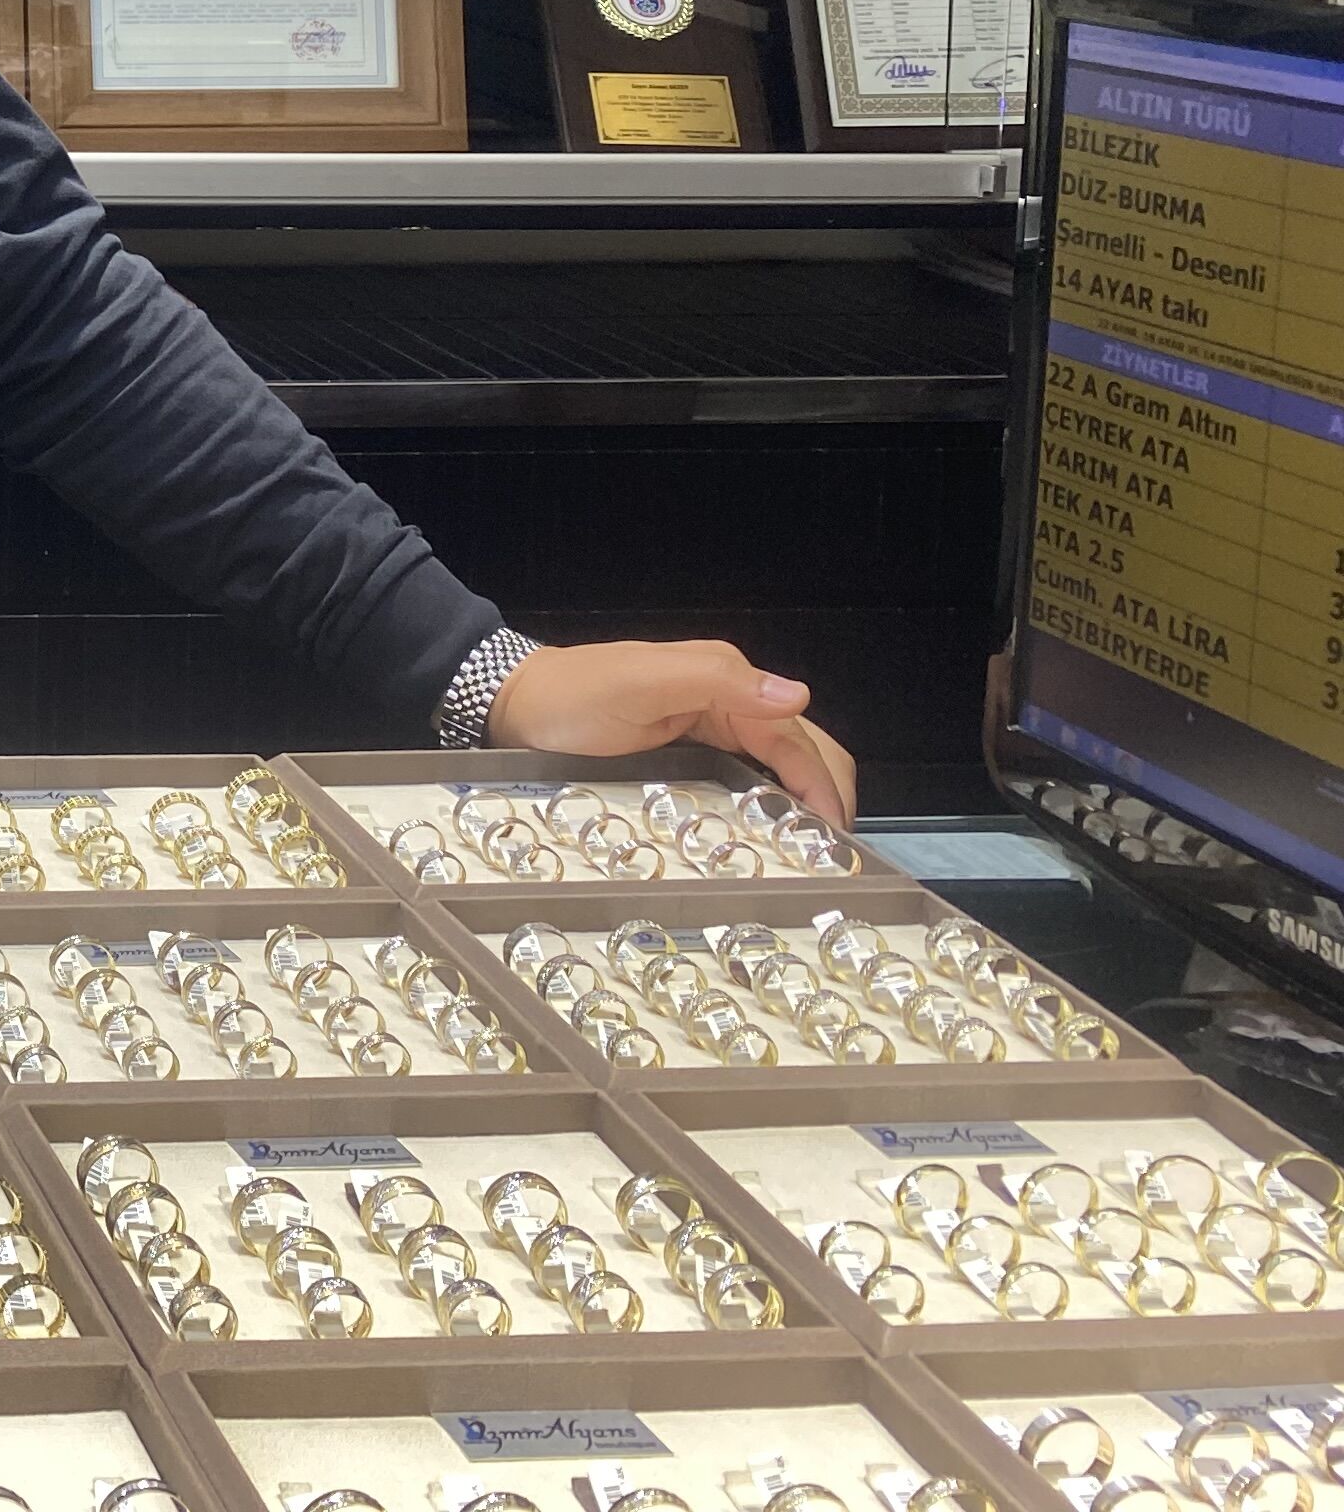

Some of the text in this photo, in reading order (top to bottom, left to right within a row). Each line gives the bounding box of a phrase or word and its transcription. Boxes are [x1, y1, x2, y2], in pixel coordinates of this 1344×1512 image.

[1097, 86, 1252, 137] ALTIN TÜRÜ
[1063, 122, 1161, 169] BİLEZİK
[1061, 168, 1207, 229] DÜZ-BURMA
[1056, 217, 1146, 262] Şarnelli
[1171, 245, 1266, 293] Desenli
[1055, 264, 1209, 329] 14 AYAR takı
[1102, 341, 1209, 394] ZİYNETLER
[1047, 361, 1237, 445] 22 A Gram Altın
[1045, 401, 1190, 474] ÇEYREK ATA
[1041, 439, 1174, 510] YARIM ATA
[1038, 478, 1135, 537] TEK ATA
[1036, 520, 1125, 574] ATA 2.5
[1034, 559, 1230, 664] Cumh. ATA LİRA
[542, 1417, 637, 1451] Alyans
